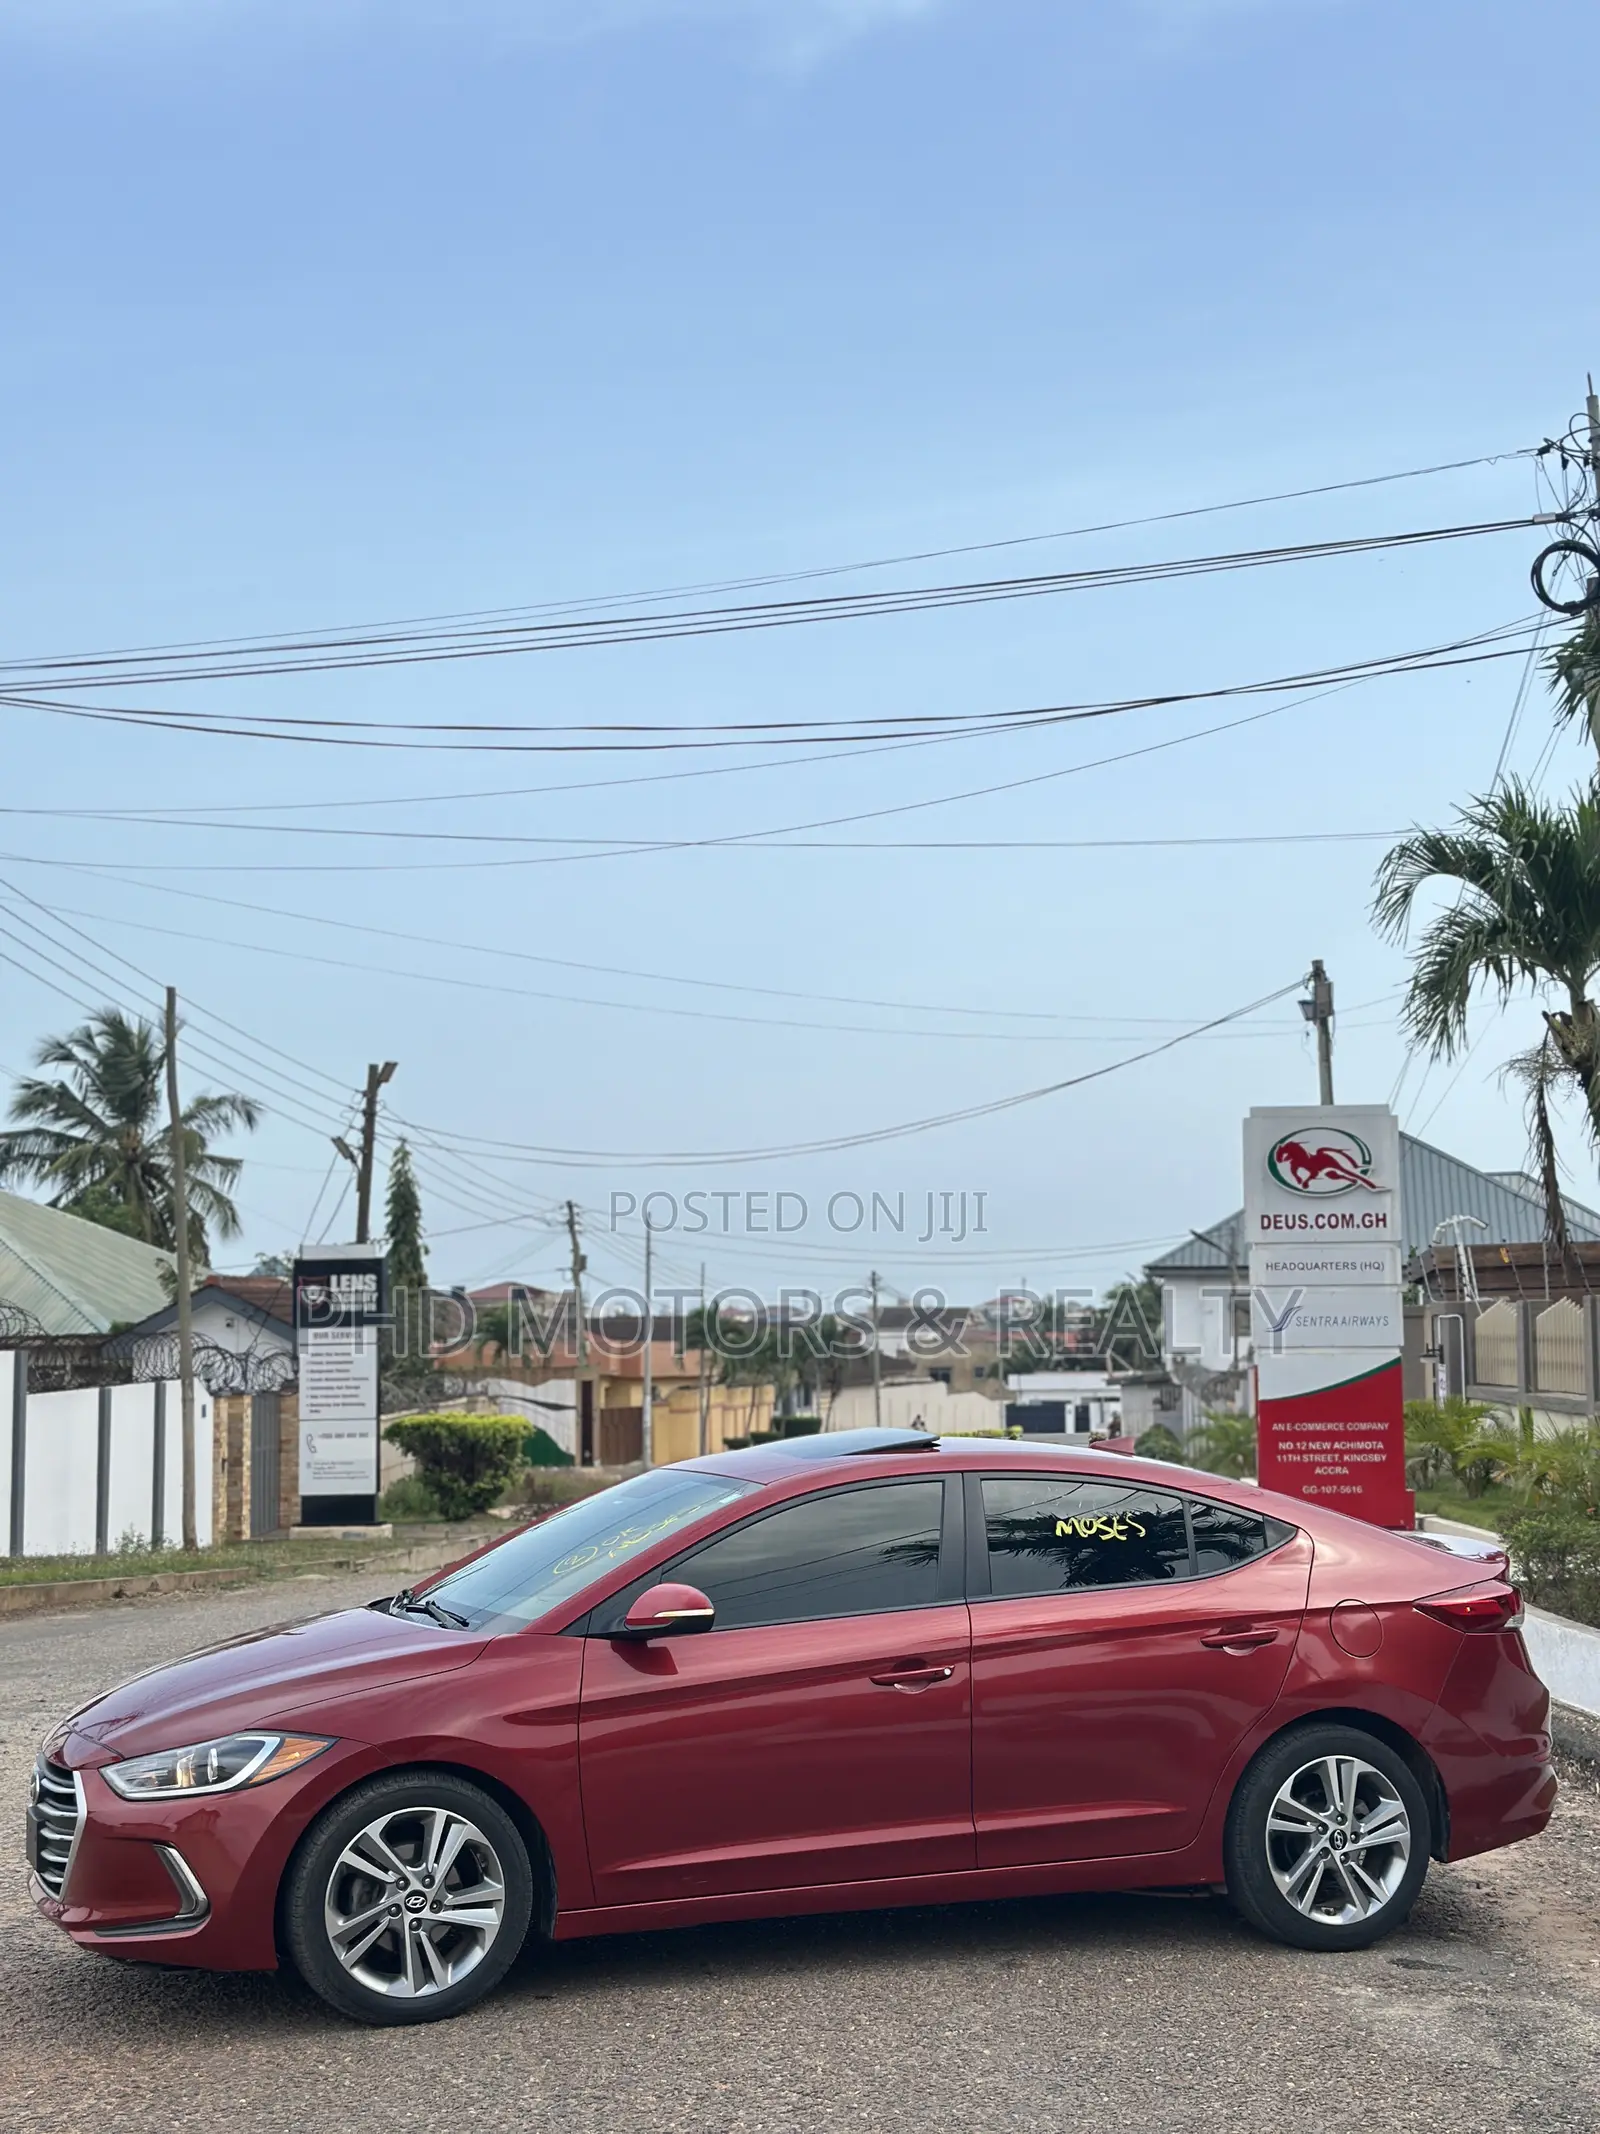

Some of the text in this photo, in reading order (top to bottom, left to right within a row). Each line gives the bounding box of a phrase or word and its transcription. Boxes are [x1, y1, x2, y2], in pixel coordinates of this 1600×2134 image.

[1260, 1213, 1388, 1230] DEUS.COM.GH
[1265, 1261, 1385, 1272] HEADQUARTERS (HQ)
[330, 1274, 378, 1292] LENS
[1347, 1422, 1389, 1430] COMPANY
[1309, 1441, 1331, 1450] NEW
[1333, 1441, 1384, 1450] ACHIMOTA
[1277, 1454, 1300, 1462] 11TH
[1343, 1453, 1387, 1462] KINGSBY
[1314, 1466, 1349, 1475] ACCRA
[1055, 1511, 1146, 1540] MOSES
